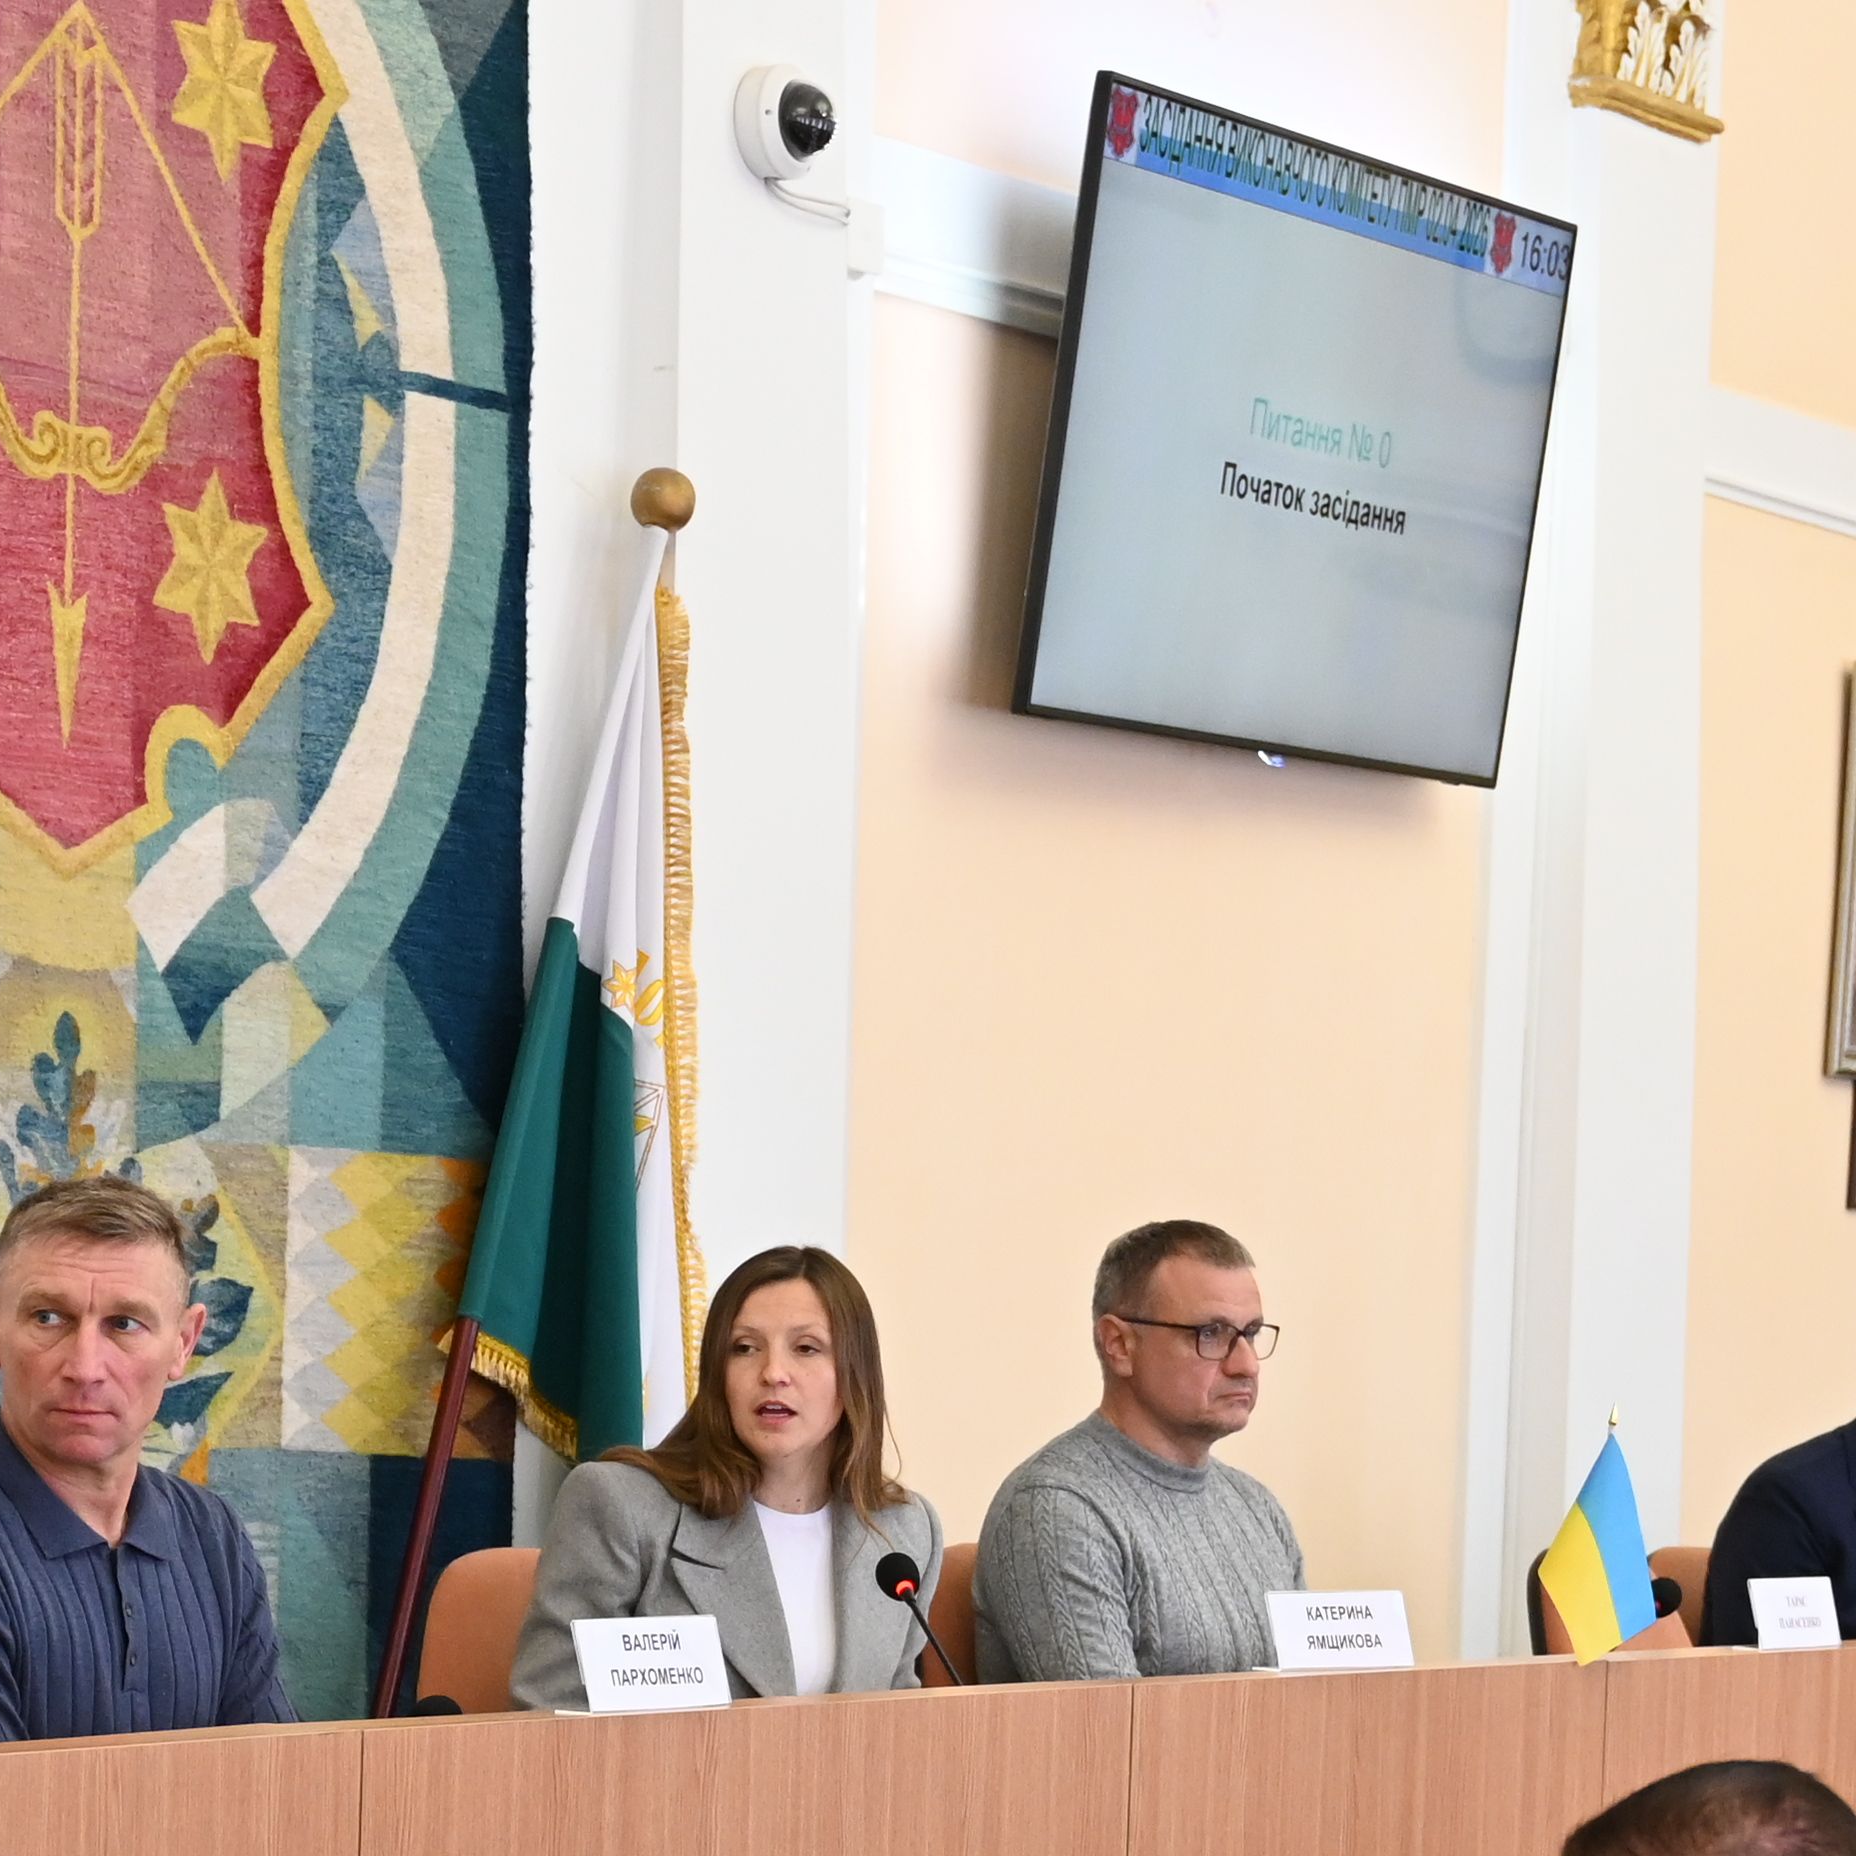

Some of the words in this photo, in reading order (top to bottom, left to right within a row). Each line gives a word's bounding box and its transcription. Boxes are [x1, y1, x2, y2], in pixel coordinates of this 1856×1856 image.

[1139, 96, 1227, 176] ЗАСІДАННЯ
[1225, 124, 1329, 207] ВИКОНАВЧОГО
[1328, 156, 1400, 228] КОМІТЕТУ
[1394, 178, 1428, 237] ПМР
[1249, 397, 1343, 457] Питання
[1348, 423, 1374, 462] №
[1378, 431, 1393, 469] 0
[1220, 461, 1306, 513] Початок
[1308, 490, 1407, 535] засідання
[1305, 1604, 1374, 1621] КАТЕРИНА
[621, 1629, 682, 1651] ВАЛЕРІЙ
[1306, 1633, 1383, 1651] ЯМЩИКОВА
[610, 1666, 704, 1687] ПАРХОМЕНКО
